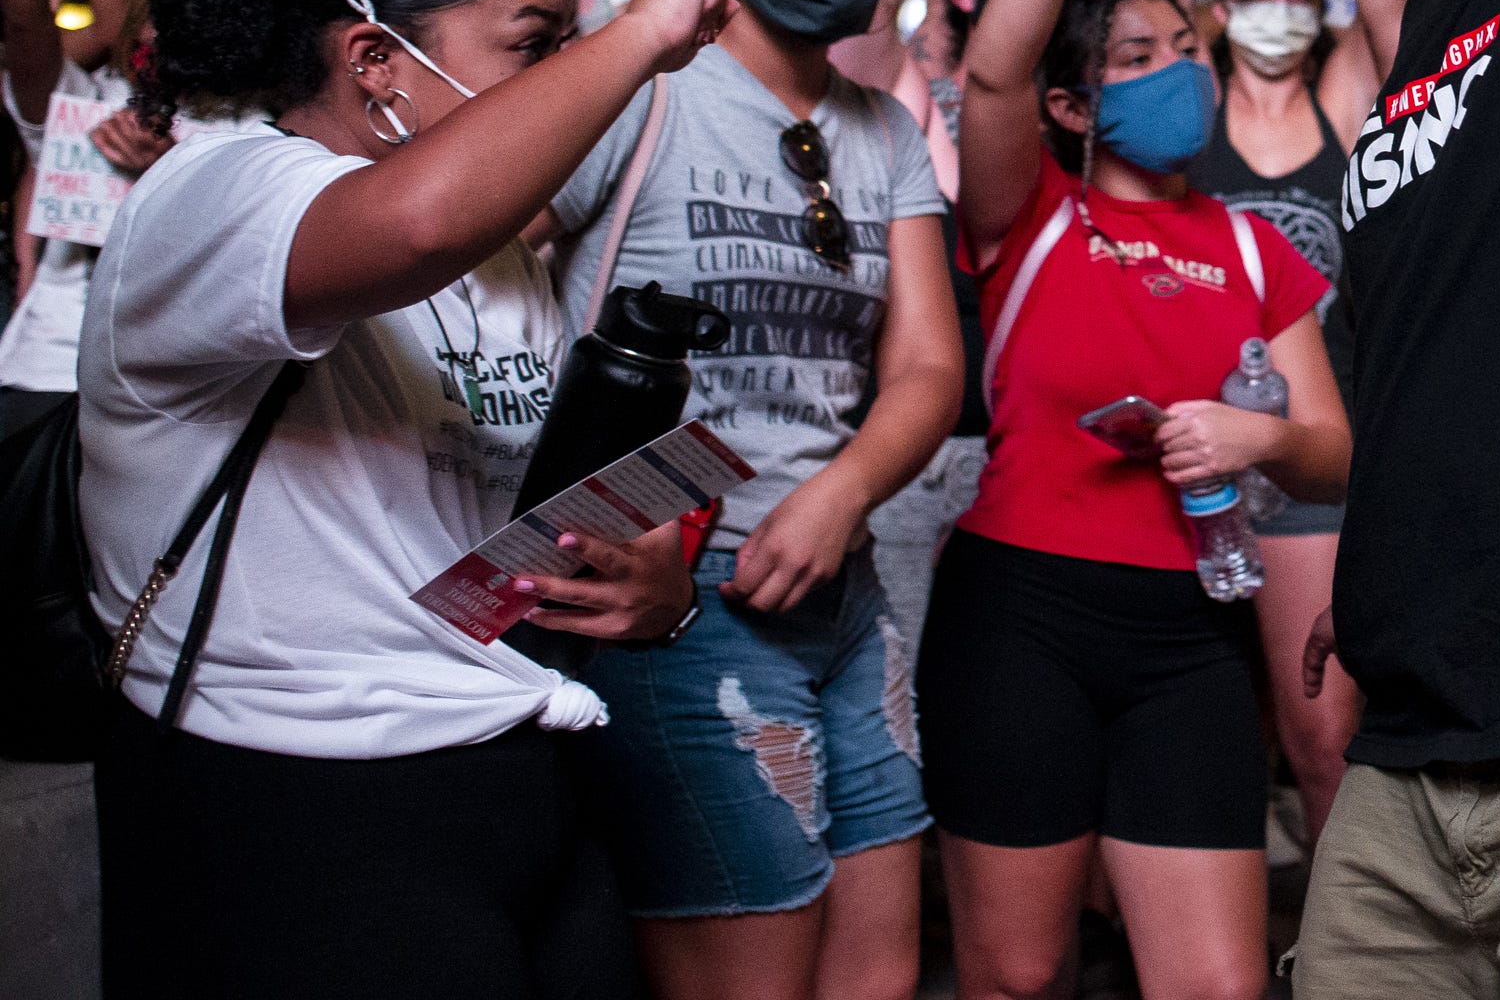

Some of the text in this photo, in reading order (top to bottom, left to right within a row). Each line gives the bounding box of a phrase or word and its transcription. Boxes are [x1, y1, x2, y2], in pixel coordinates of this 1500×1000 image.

[689, 165, 773, 206] LOVE
[692, 205, 765, 236] BLACK
[696, 243, 784, 274] CLIMATE
